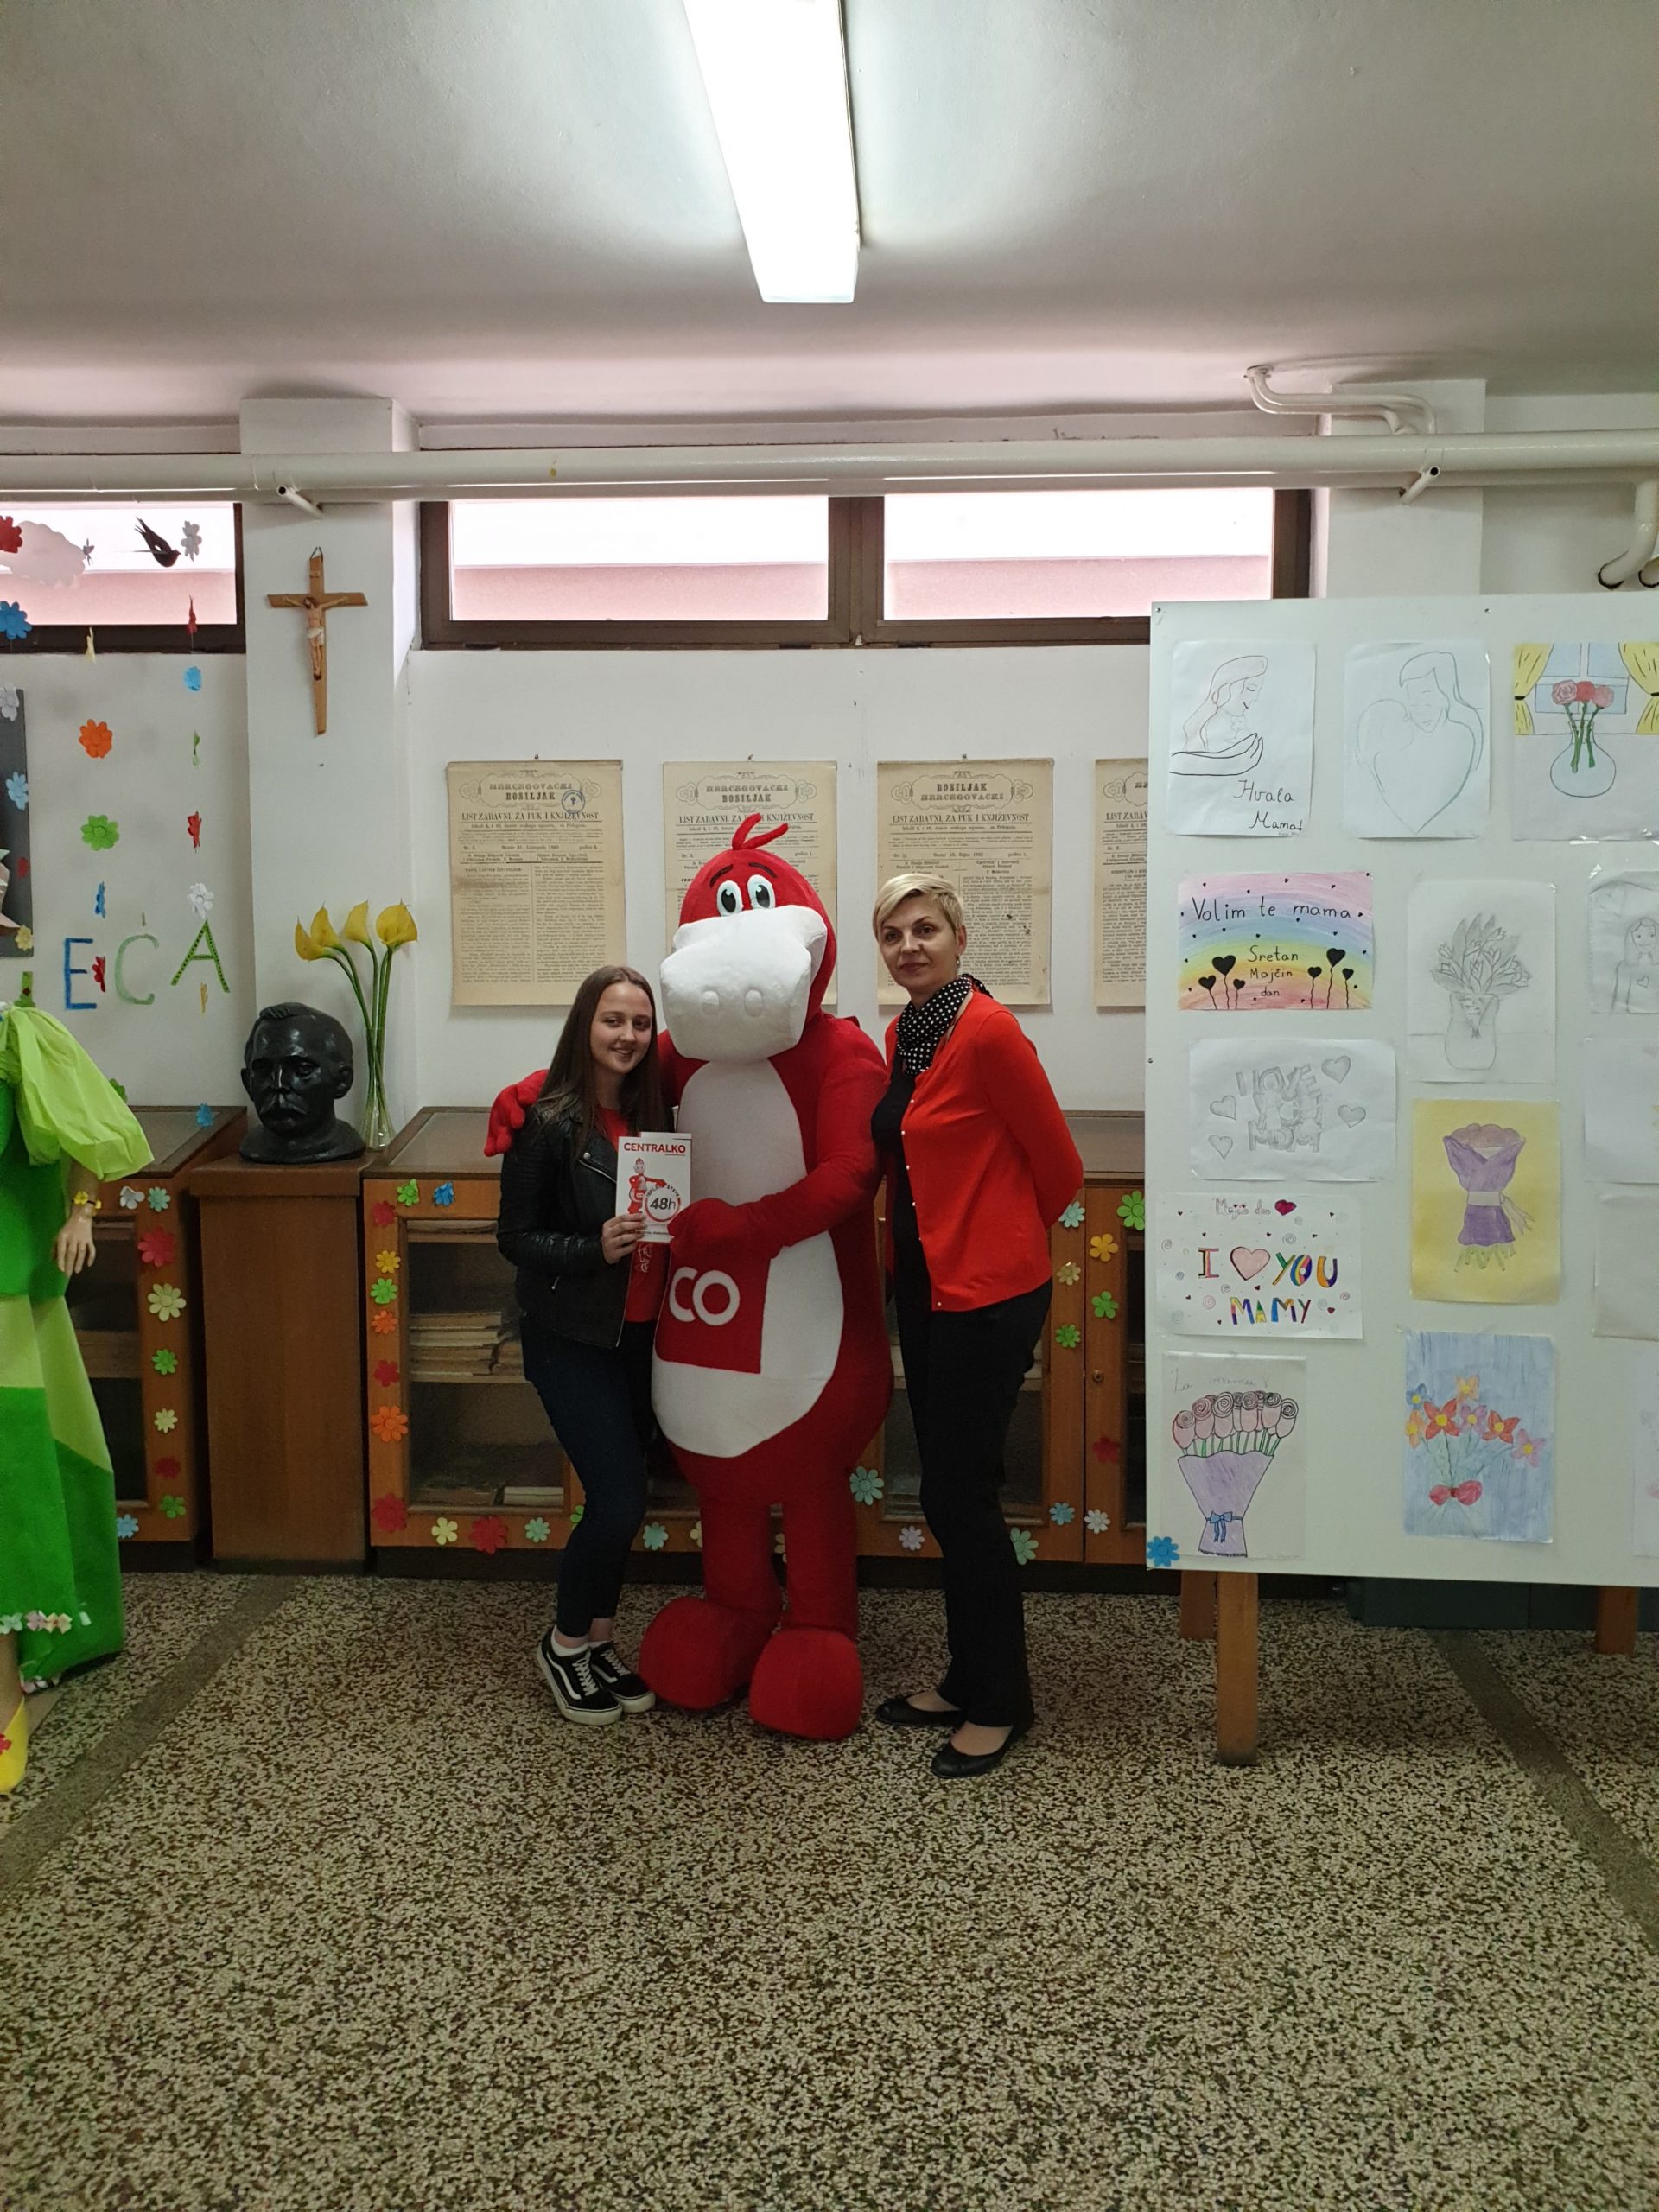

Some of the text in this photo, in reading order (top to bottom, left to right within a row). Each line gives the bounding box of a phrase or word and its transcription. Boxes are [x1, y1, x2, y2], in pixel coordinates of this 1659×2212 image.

[936, 783, 988, 791] BOSILJAK
[1233, 779, 1294, 803] Hvala
[505, 792, 556, 801] BOSILJAK
[721, 794, 772, 803] BOSILJAK
[461, 812, 477, 821] LIST
[679, 815, 694, 823] LIST
[893, 815, 908, 823] LIST
[945, 814, 956, 823] ZA
[957, 814, 972, 823] PUK
[1192, 896, 1351, 922] Volim te mama
[1248, 944, 1299, 963] Sretan
[1249, 968, 1294, 983] Majčin
[1261, 986, 1280, 997] dan
[1236, 1071, 1247, 1096] I
[623, 1141, 686, 1154] CENTRALKO
[650, 1198, 676, 1210] 48h
[1198, 1247, 1338, 1288] I YOU
[669, 1266, 741, 1326] CO
[1230, 1297, 1312, 1325] MAMY
